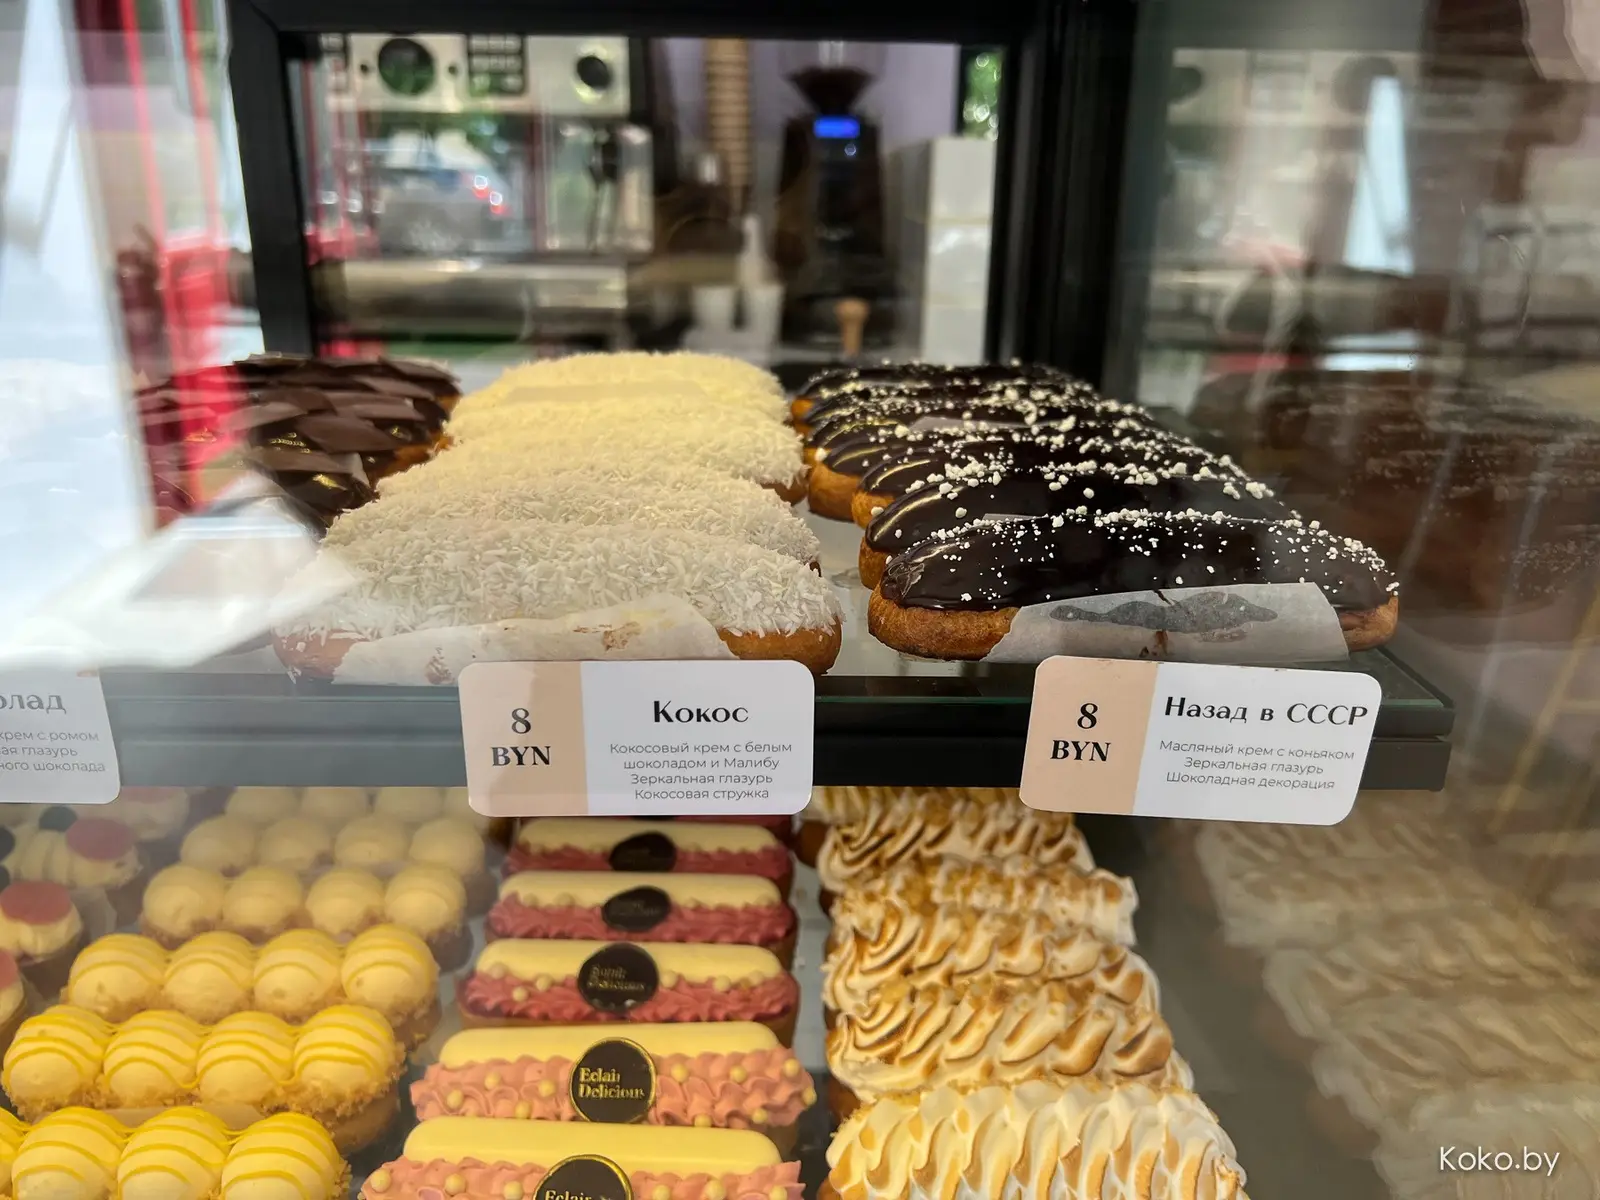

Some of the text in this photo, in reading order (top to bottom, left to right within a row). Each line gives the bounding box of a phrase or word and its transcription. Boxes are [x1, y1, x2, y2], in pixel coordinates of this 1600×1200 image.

[652, 700, 749, 723] Кокос
[1077, 702, 1098, 730] 8
[1164, 696, 1368, 726] Назад в СССР
[511, 707, 532, 735] 8
[37, 732, 48, 741] с
[50, 732, 100, 742] ромом
[0, 746, 78, 758] ая глазурь
[490, 745, 552, 767] BYN
[609, 741, 792, 756] Кокосовый крем с белым
[1050, 739, 1111, 762] BYN
[1159, 740, 1355, 760] Масляный крем с коньяком
[33, 761, 106, 773] шоколада
[623, 757, 780, 770] шоколадом и Малибу
[1183, 757, 1323, 776] Зеркальная глазурь
[630, 773, 773, 787] Зеркальная глазурь
[1166, 771, 1335, 791] Шоколадная декорация
[634, 788, 769, 801] Кокосовая стружка
